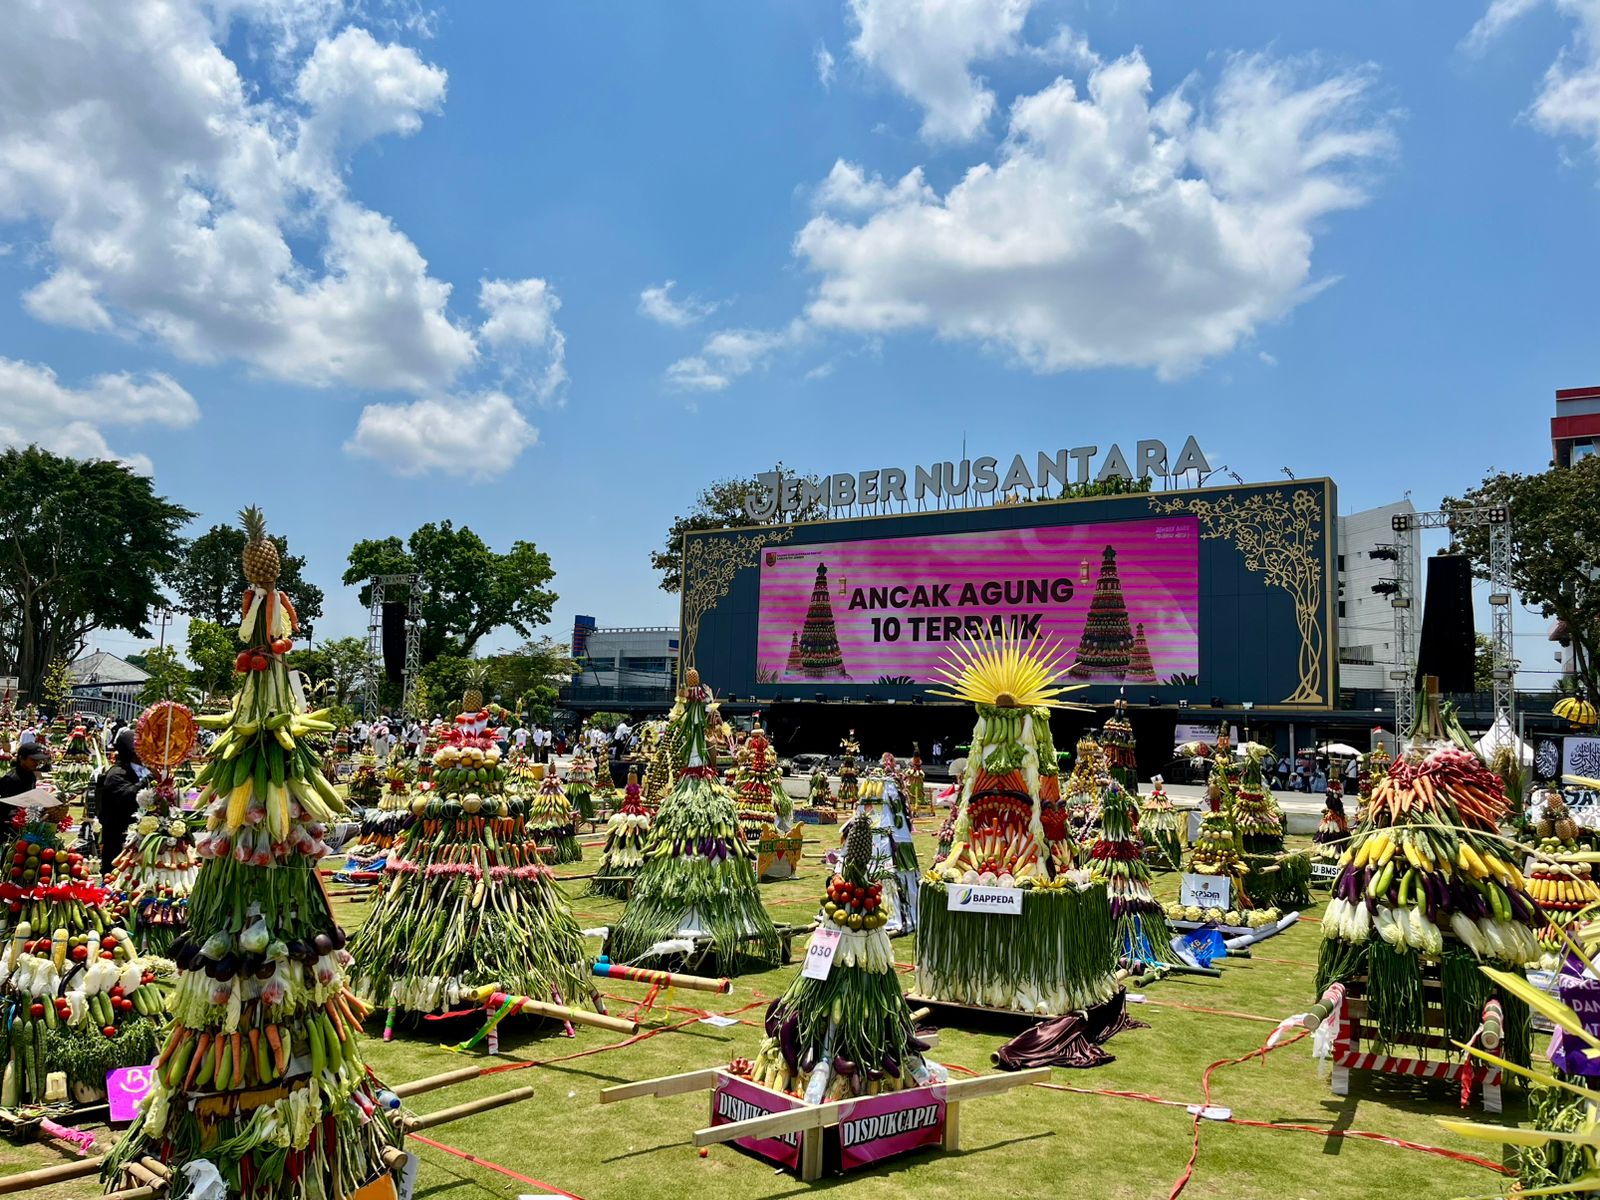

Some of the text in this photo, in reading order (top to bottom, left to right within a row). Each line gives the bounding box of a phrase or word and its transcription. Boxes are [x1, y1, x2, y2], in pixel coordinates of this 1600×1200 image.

[744, 435, 1211, 521] JEMBER NUSANTARA
[848, 578, 1074, 610] ANCAK AGUNG
[871, 613, 1043, 642] 10 TERBAIK
[972, 894, 1014, 904] BAPPEDA
[810, 945, 832, 957] 030
[843, 1104, 939, 1147] DISDUKCAPIL
